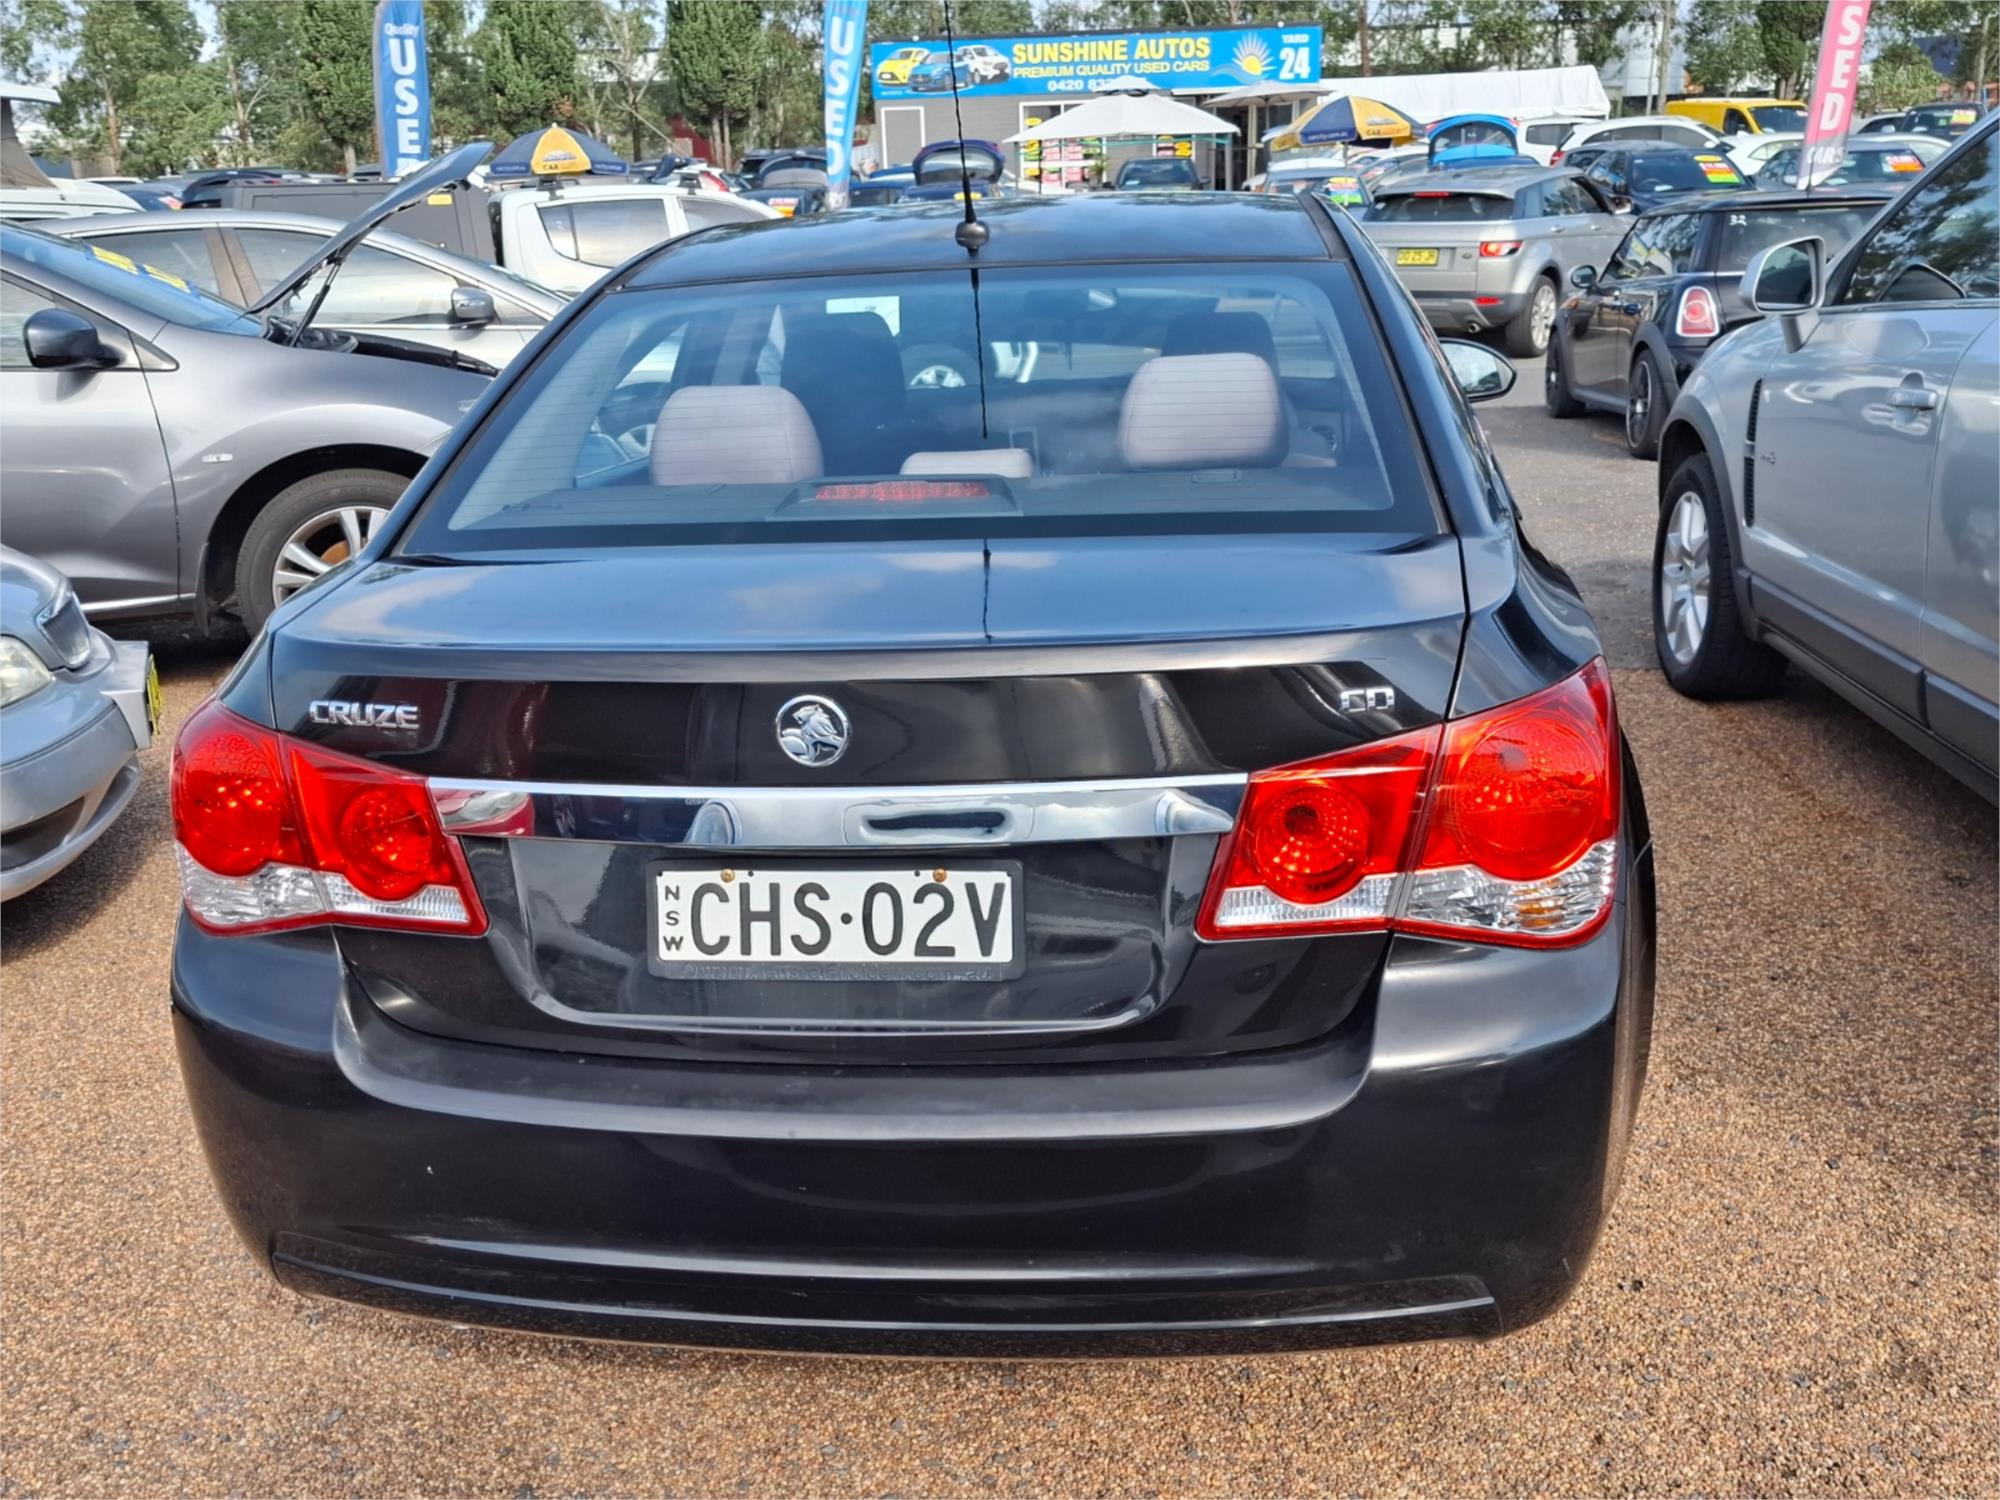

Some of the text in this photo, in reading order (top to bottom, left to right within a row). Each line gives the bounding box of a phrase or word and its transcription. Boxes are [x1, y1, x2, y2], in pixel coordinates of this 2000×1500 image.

[384, 23, 419, 38] Quality
[1281, 33, 1309, 44] YARD
[1012, 37, 1211, 65] SUNSHINE AUTOS
[1013, 60, 1210, 79] PREMIUM QUALITY USED CARS
[1279, 47, 1311, 80] 24
[1818, 0, 1864, 131] SED
[1047, 79, 1084, 92] 0420
[309, 700, 420, 729] CRUZE
